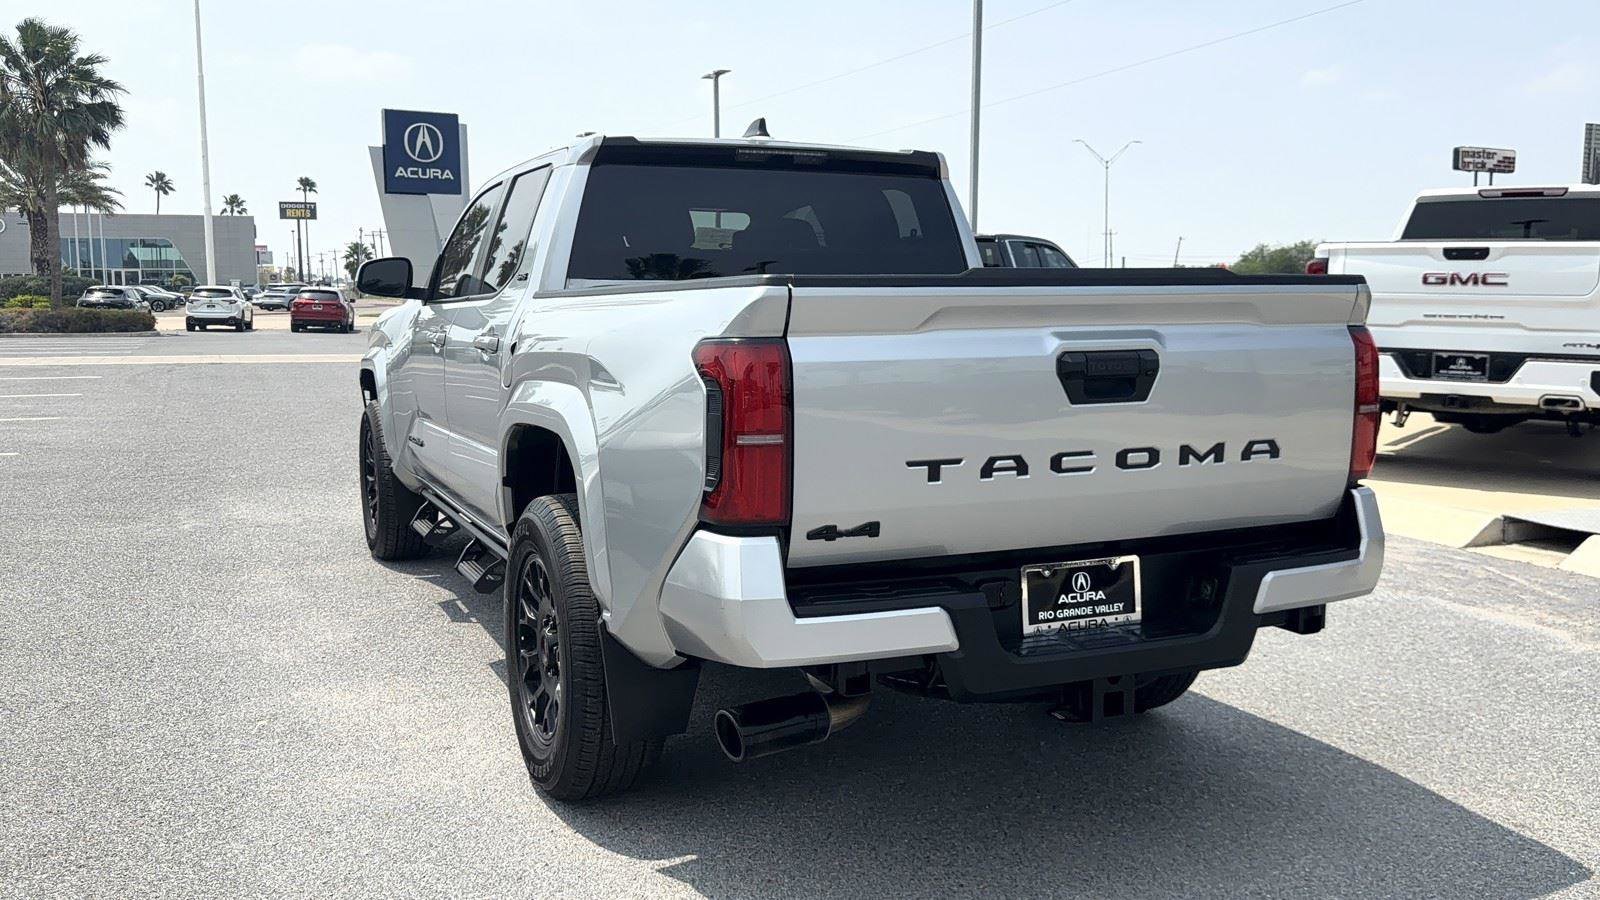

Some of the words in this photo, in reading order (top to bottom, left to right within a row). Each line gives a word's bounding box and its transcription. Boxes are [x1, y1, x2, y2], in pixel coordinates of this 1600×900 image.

[1461, 149, 1498, 160] master
[1461, 160, 1487, 169] brick
[394, 166, 454, 180] ACURA
[286, 209, 312, 218] RENTS
[1422, 272, 1509, 286] GMC
[905, 439, 1281, 485] TACOMA
[1058, 590, 1106, 604] ACURA
[1038, 609, 1055, 620] RIO
[1056, 606, 1094, 618] GRANDE
[1094, 602, 1125, 614] VALLEY
[1057, 617, 1109, 633] ACURA
